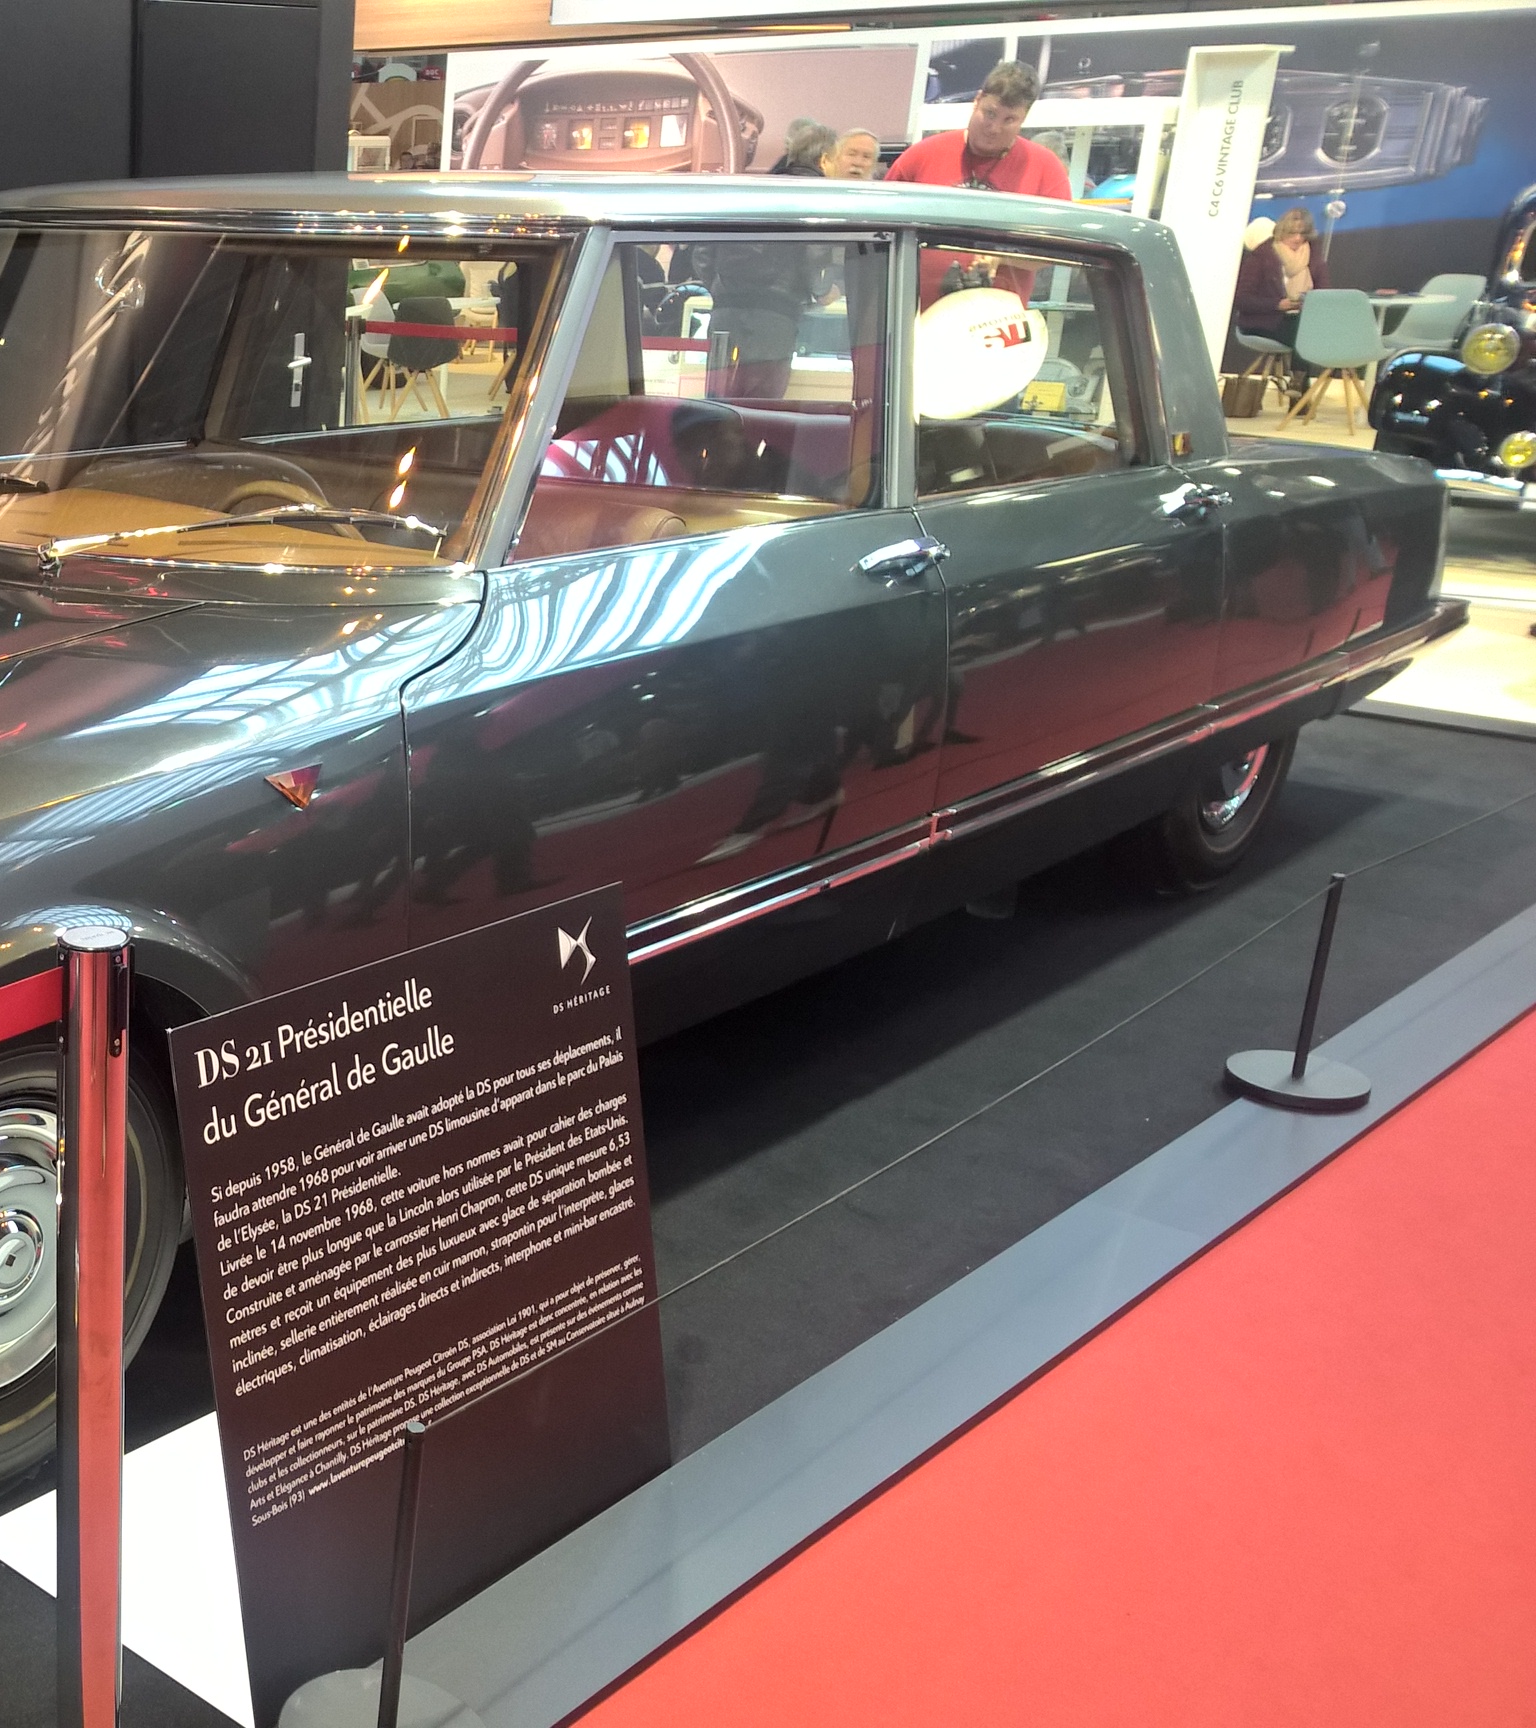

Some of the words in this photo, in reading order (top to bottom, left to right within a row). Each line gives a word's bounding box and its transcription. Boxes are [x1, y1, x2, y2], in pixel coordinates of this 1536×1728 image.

[1216, 119, 1236, 176] VINTAGE
[1228, 80, 1244, 115] CLUB
[1209, 200, 1220, 217] C4
[1212, 179, 1224, 197] C6
[194, 1038, 240, 1088] DS
[245, 1040, 273, 1071] 21
[278, 977, 432, 1059] Présidentielle
[553, 1001, 564, 1015] DS
[203, 1105, 237, 1144] du
[244, 1061, 342, 1127] Général
[347, 1053, 376, 1090] de
[382, 1024, 454, 1075] Gaulle
[211, 1185, 223, 1203] Si
[225, 1171, 262, 1197] depuis
[265, 1155, 299, 1180] 1958,
[301, 1150, 312, 1166] le
[314, 1130, 355, 1161] Général
[356, 1126, 370, 1144] de
[371, 1113, 405, 1137] Gaulle
[406, 1104, 429, 1125] avait
[431, 1089, 464, 1115] adopté
[465, 1085, 475, 1101] la
[476, 1077, 492, 1096] DS
[493, 1072, 515, 1094] pour
[515, 1064, 536, 1081] tous
[537, 1058, 552, 1072] ses
[553, 1034, 614, 1066] déplacements,
[615, 1025, 622, 1041] il
[214, 1201, 250, 1227] faudra
[252, 1182, 297, 1212] attendre
[299, 1167, 329, 1192] 1968
[331, 1160, 355, 1184] pour
[356, 1150, 375, 1168] voir
[376, 1138, 407, 1161] arriver
[408, 1131, 428, 1147] une
[428, 1119, 444, 1139] DS
[444, 1105, 490, 1132] limousine
[535, 1078, 557, 1095] dans
[557, 1071, 566, 1086] le
[567, 1066, 586, 1086] parc
[586, 1058, 598, 1074] du
[598, 1049, 623, 1069] Palais
[217, 1233, 232, 1252] de
[281, 1208, 292, 1224] la
[294, 1198, 311, 1219] DS
[313, 1191, 328, 1211] 21
[331, 1163, 401, 1204] Présidentielle.
[220, 1252, 253, 1276] Livrée
[255, 1244, 267, 1260] le
[271, 1234, 286, 1254] 14
[289, 1215, 341, 1246] novembre
[345, 1196, 377, 1221] 1968,
[380, 1188, 405, 1206] cette
[407, 1172, 440, 1195] voiture
[442, 1162, 464, 1180] hors
[466, 1146, 501, 1170] normes
[503, 1134, 525, 1154] avait
[526, 1126, 548, 1148] pour
[549, 1114, 576, 1134] cahier
[577, 1106, 593, 1122] des
[595, 1092, 627, 1115] charges
[223, 1282, 238, 1300] de
[241, 1267, 274, 1292] devoir
[277, 1258, 299, 1276] être
[301, 1246, 324, 1270] plus
[326, 1230, 362, 1254] longue
[365, 1220, 384, 1240] que
[386, 1212, 397, 1228] la
[399, 1196, 434, 1223] Lincoln
[436, 1187, 460, 1206] alors
[462, 1171, 494, 1195] utilisée
[496, 1164, 512, 1184] par
[513, 1156, 523, 1172] le
[524, 1139, 565, 1167] Président
[567, 1132, 583, 1148] des
[226, 1290, 283, 1324] Construite
[285, 1282, 296, 1298] et
[298, 1258, 352, 1292] aménagée
[354, 1250, 371, 1271] par
[372, 1242, 383, 1258] le
[384, 1223, 430, 1253] carrossier
[431, 1207, 459, 1232] Henri
[460, 1192, 503, 1218] Chapron,
[505, 1180, 528, 1198] cette
[529, 1169, 544, 1188] DS
[545, 1159, 575, 1180] unique
[576, 1144, 608, 1167] mesure
[609, 1130, 630, 1152] 6,53
[229, 1322, 267, 1349] mètres
[270, 1314, 281, 1330] et
[284, 1299, 314, 1323] reçoit
[316, 1293, 331, 1308] un
[333, 1263, 393, 1300] équipement
[396, 1254, 414, 1271] des
[416, 1244, 437, 1266] plus
[438, 1226, 477, 1251] luxueux
[479, 1215, 500, 1233] avec
[501, 1204, 525, 1227] glace
[527, 1194, 539, 1211] de
[541, 1176, 586, 1205] séparation
[587, 1159, 622, 1183] bombée
[623, 1153, 633, 1167] et
[232, 1344, 277, 1373] inclinée,
[280, 1323, 317, 1350] sellerie
[318, 1293, 380, 1332] entièrement
[381, 1276, 418, 1303] réalisée
[419, 1270, 432, 1284] en
[433, 1259, 451, 1278] cuir
[452, 1245, 489, 1269] marron,
[490, 1220, 536, 1251] strapontin
[536, 1211, 557, 1233] pour
[608, 1175, 635, 1199] glaces
[235, 1360, 296, 1396] électriques,
[299, 1327, 366, 1366] climatisation,
[368, 1301, 417, 1332] éclairages
[418, 1285, 449, 1308] directs
[450, 1278, 460, 1292] et
[461, 1261, 503, 1288] indirects,
[504, 1236, 552, 1267] interphone
[553, 1229, 563, 1243] et
[599, 1194, 636, 1221] encastré.
[243, 1445, 256, 1461] DS
[290, 1423, 302, 1437] est
[303, 1417, 318, 1431] une
[318, 1409, 332, 1423] des
[357, 1389, 367, 1403] de
[404, 1357, 432, 1379] Peugeot
[252, 1500, 288, 1527] Sous-Bois
[289, 1488, 305, 1508] (93)
